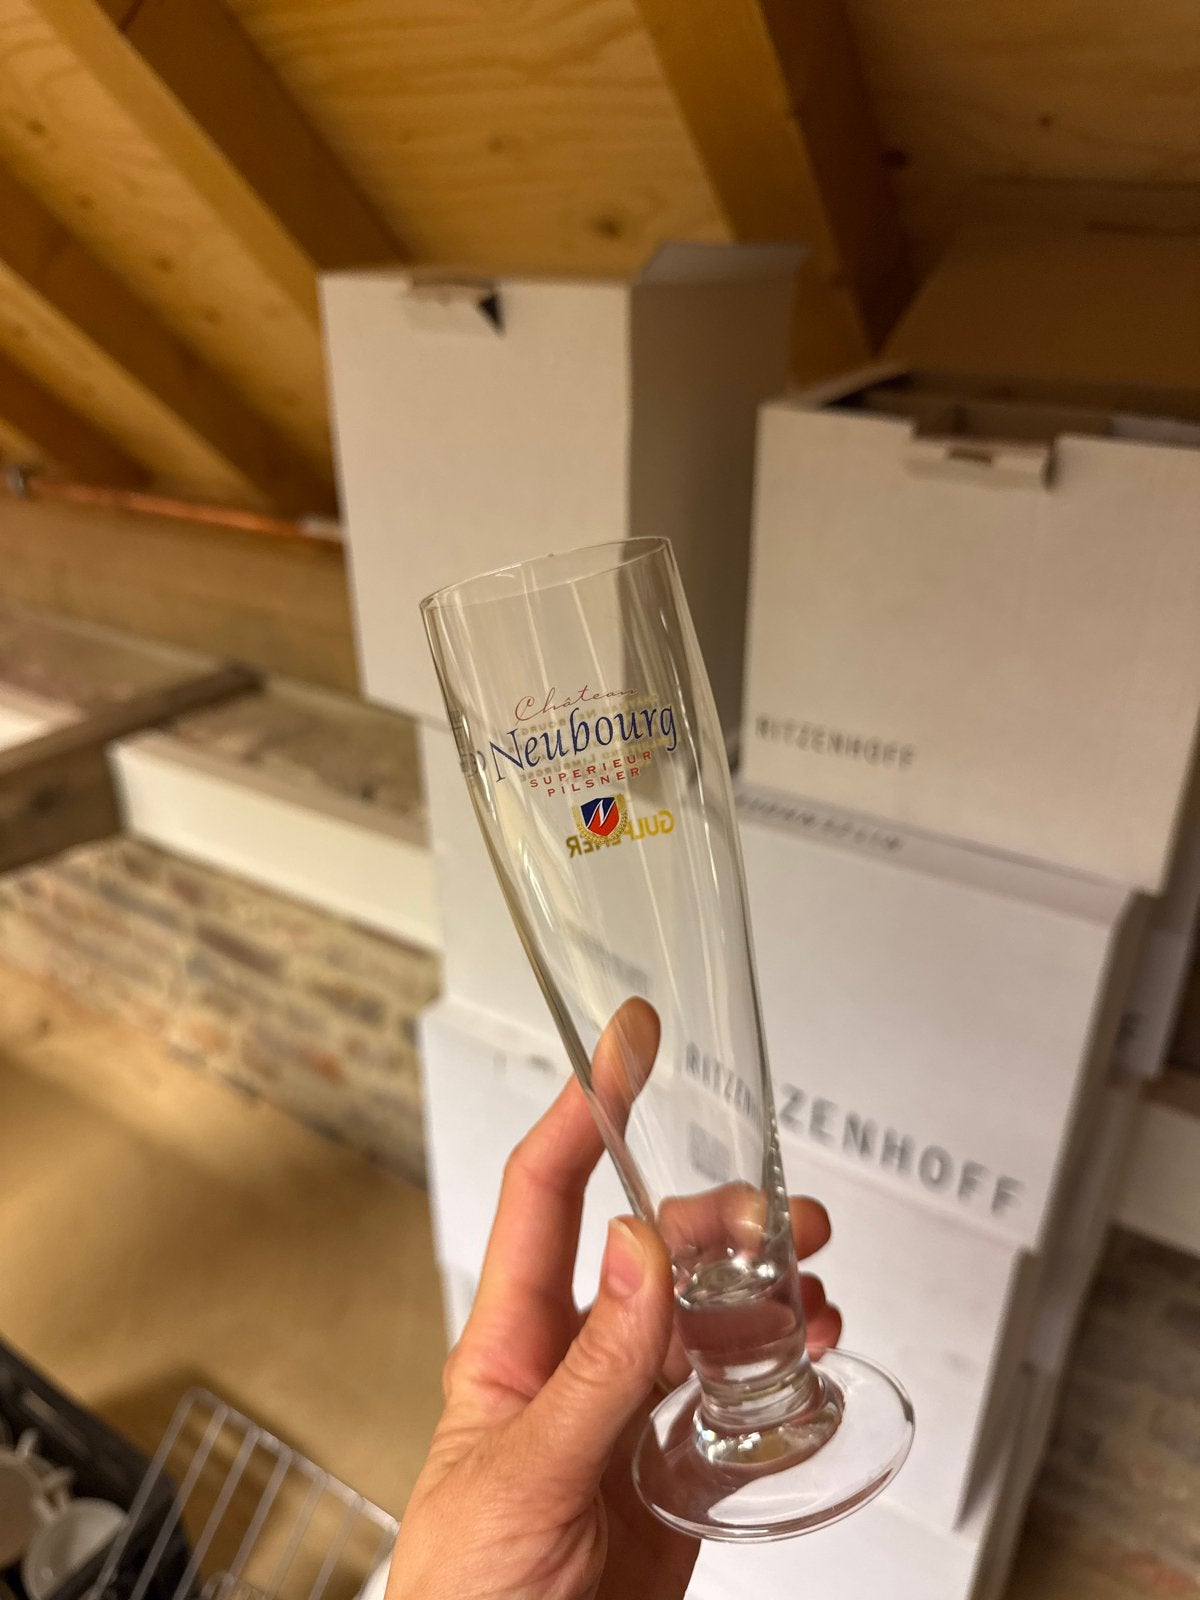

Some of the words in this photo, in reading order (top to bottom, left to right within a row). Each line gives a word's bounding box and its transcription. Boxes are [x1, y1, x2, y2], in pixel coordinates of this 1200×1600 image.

[514, 685, 639, 726] Château
[489, 704, 678, 783] Neubourg
[529, 750, 652, 788] SUPERIEUR
[547, 766, 641, 797] PILSNER
